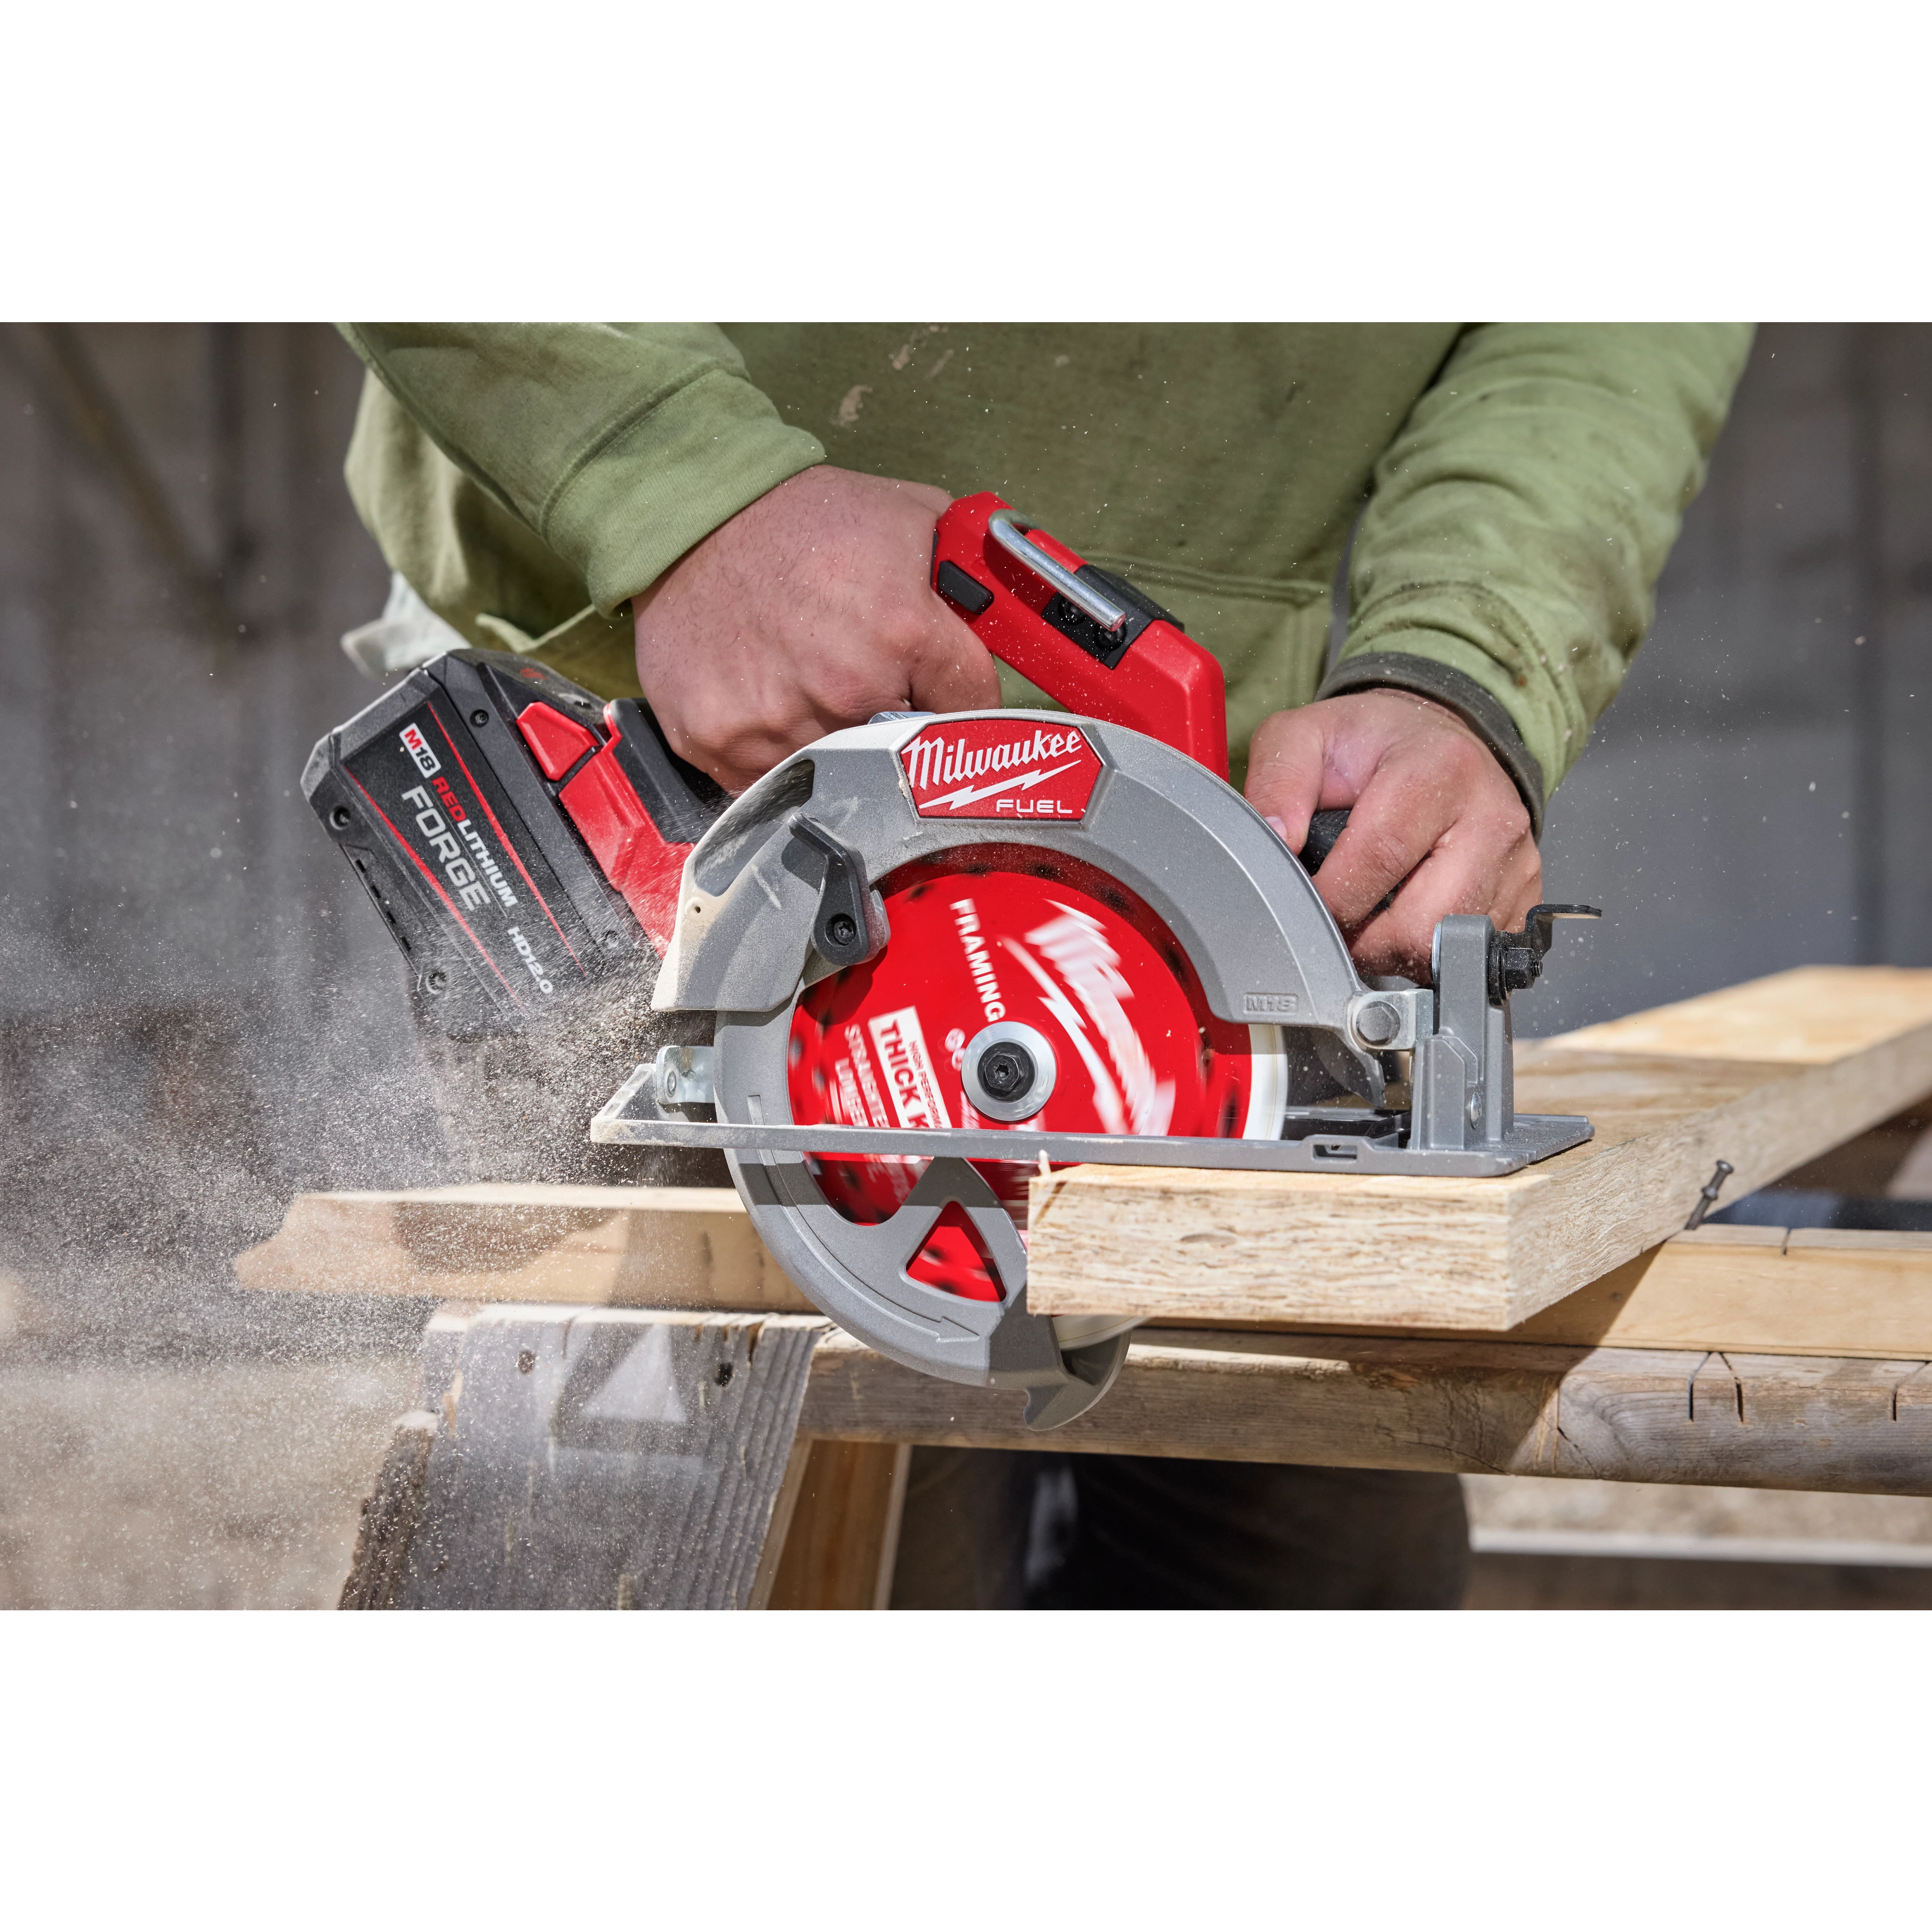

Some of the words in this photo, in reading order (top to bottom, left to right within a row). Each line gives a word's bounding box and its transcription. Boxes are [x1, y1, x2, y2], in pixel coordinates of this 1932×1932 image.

[901, 730, 1082, 790] Milwaukee
[404, 728, 436, 771] M18
[432, 776, 518, 907] REDLITHIUM
[996, 799, 1073, 814] FUEL
[401, 785, 491, 911] FORGE
[508, 926, 553, 994] HD12.0
[949, 898, 1006, 1023] FRAMING
[1245, 995, 1296, 1012] M18
[880, 1018, 922, 1109] THICK
[918, 1071, 942, 1128] PERFORM
